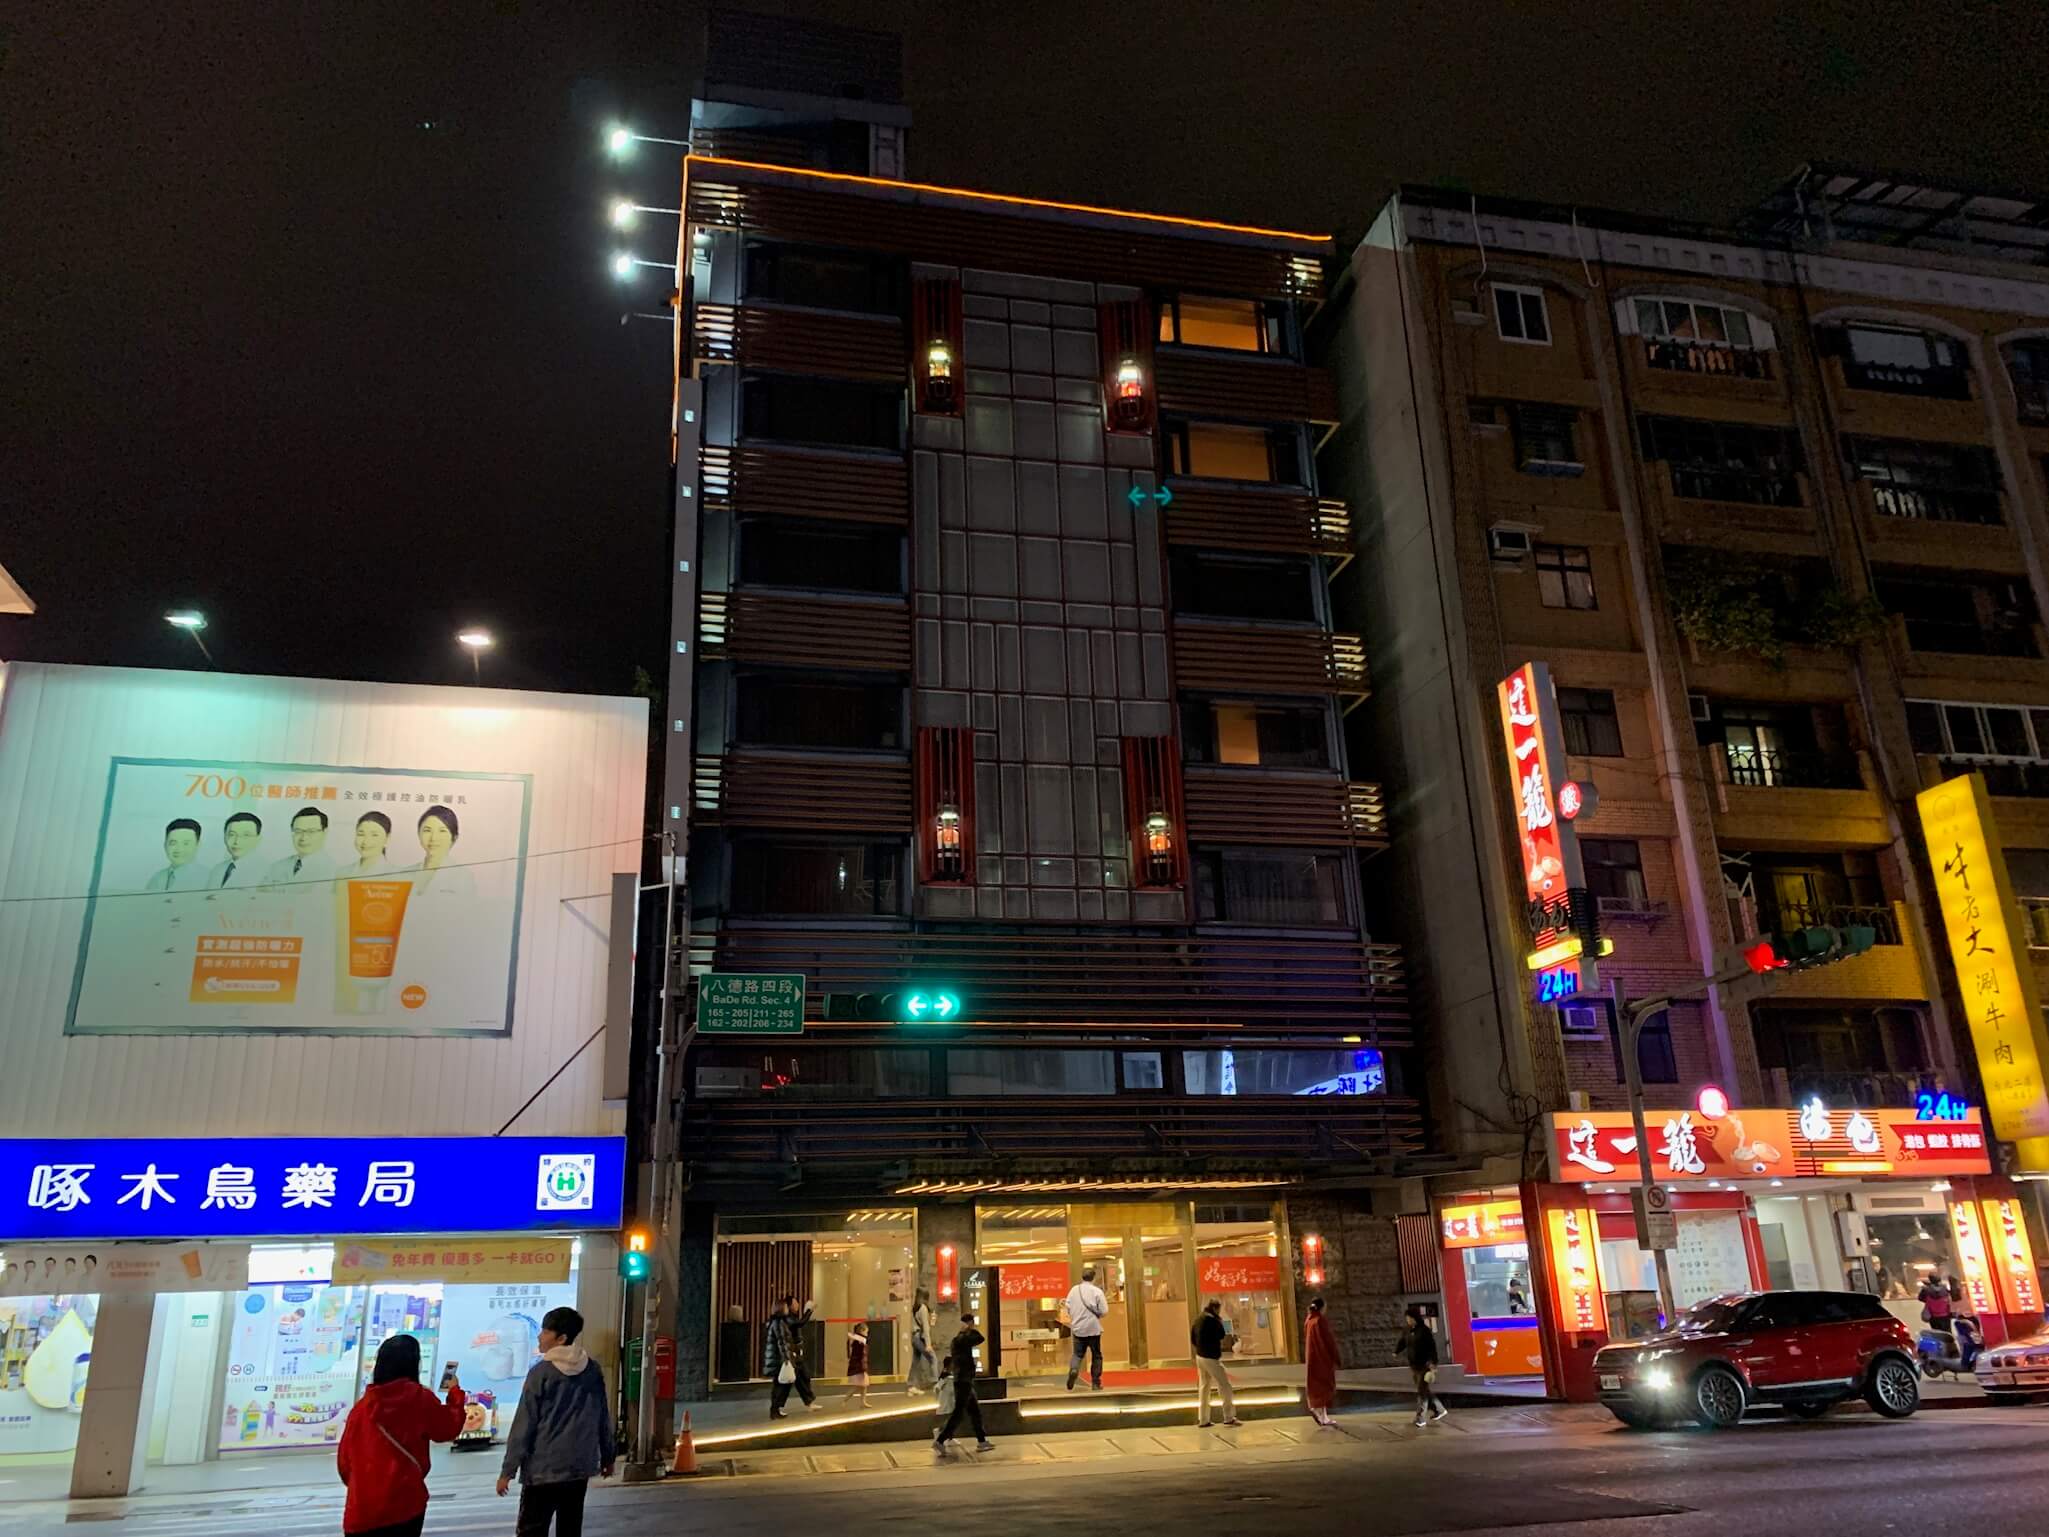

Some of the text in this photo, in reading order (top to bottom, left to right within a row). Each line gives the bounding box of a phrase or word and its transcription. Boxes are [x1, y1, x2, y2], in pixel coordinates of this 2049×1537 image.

[1508, 677, 1553, 831] 這一籠
[710, 979, 794, 993] 八德路四段
[712, 995, 791, 1005] BaDe Rd. Sec. 4
[1539, 968, 1578, 1003] 24H
[1917, 1093, 1967, 1120] 24H
[1567, 1112, 1706, 1174] 這一籠
[27, 1161, 416, 1212] 啄木鳥藥局
[392, 1252, 436, 1267] 免年費
